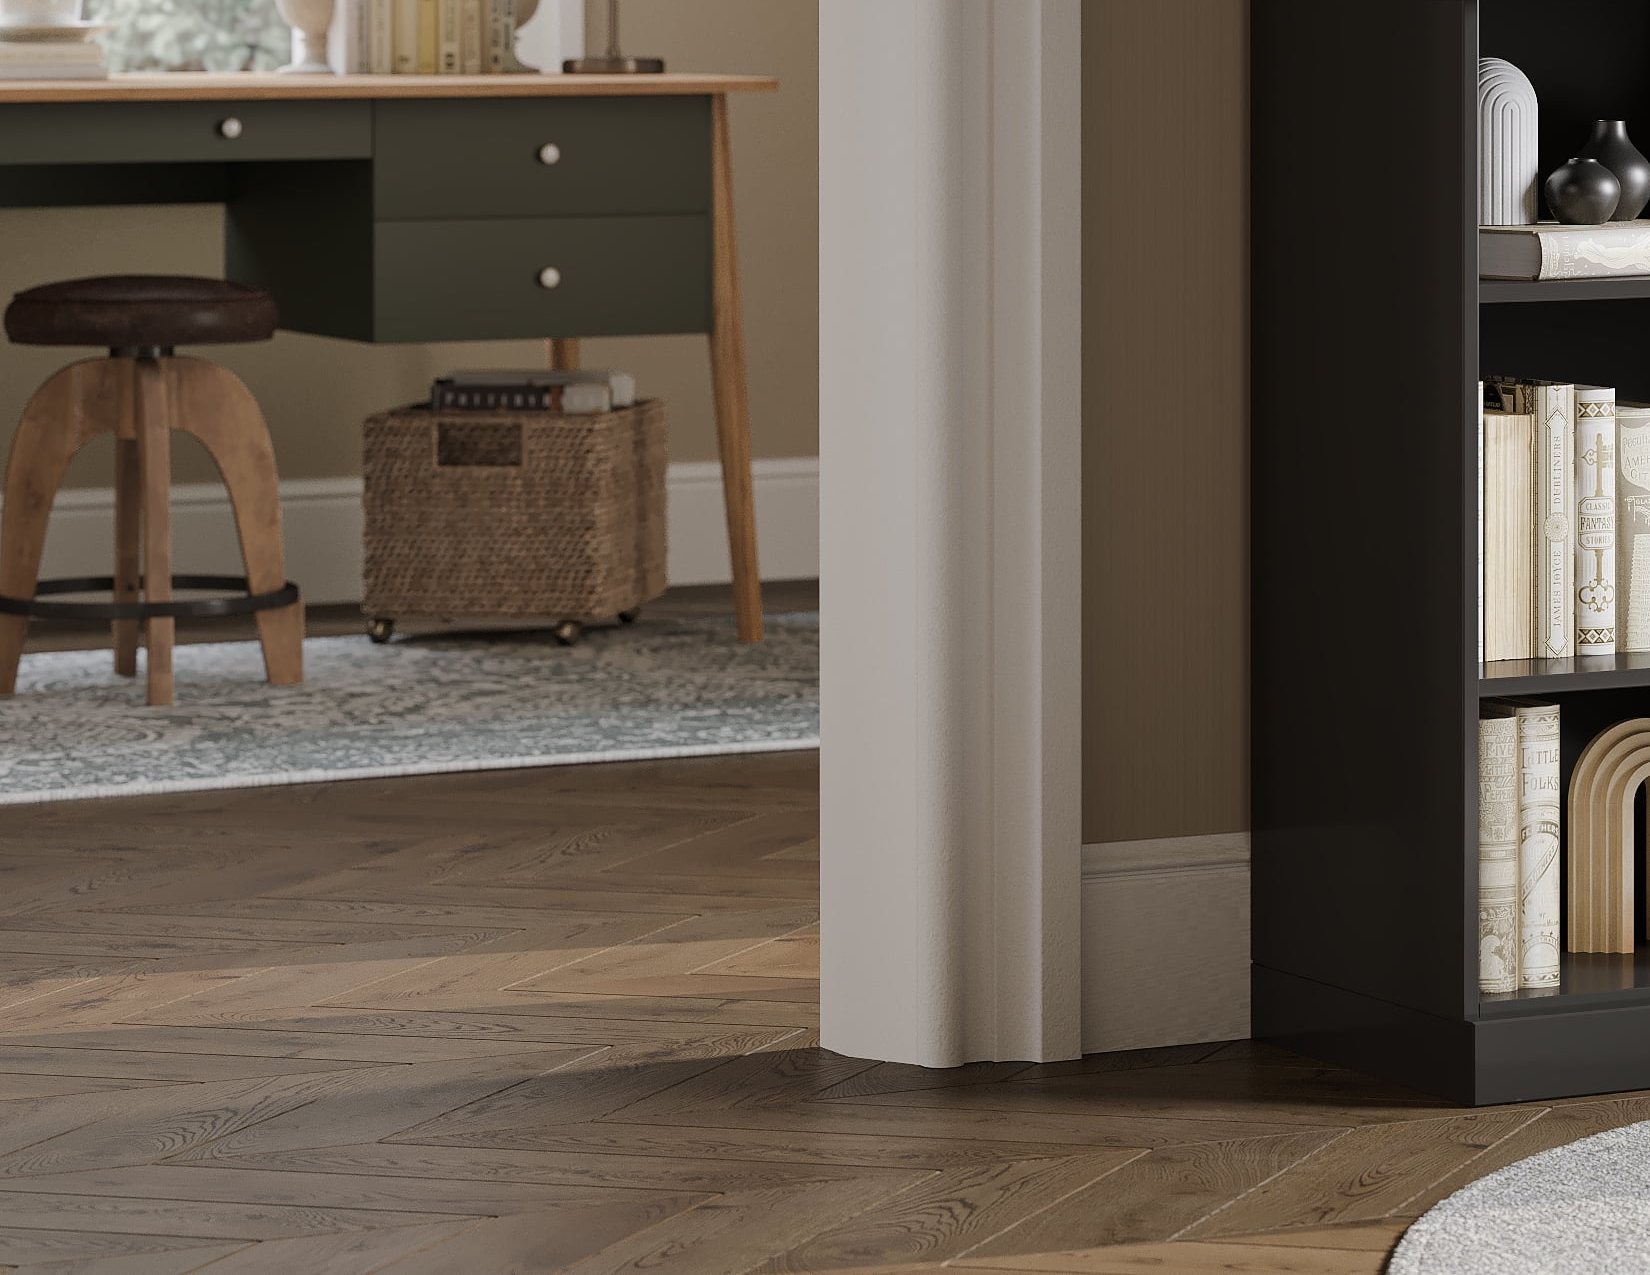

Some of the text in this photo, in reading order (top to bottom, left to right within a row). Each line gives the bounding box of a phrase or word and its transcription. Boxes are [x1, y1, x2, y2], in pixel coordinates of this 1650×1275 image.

[1552, 436, 1561, 505] DUBLINERS
[1585, 502, 1611, 512] CLASSIC
[1580, 516, 1614, 531] FANTASY
[1585, 535, 1611, 545] STORIES
[1552, 550, 1561, 627] JAMES JOYCE
[1486, 740, 1516, 757] FIVE
[1520, 746, 1560, 769] LITTLE
[1520, 772, 1560, 797] FOLKS
